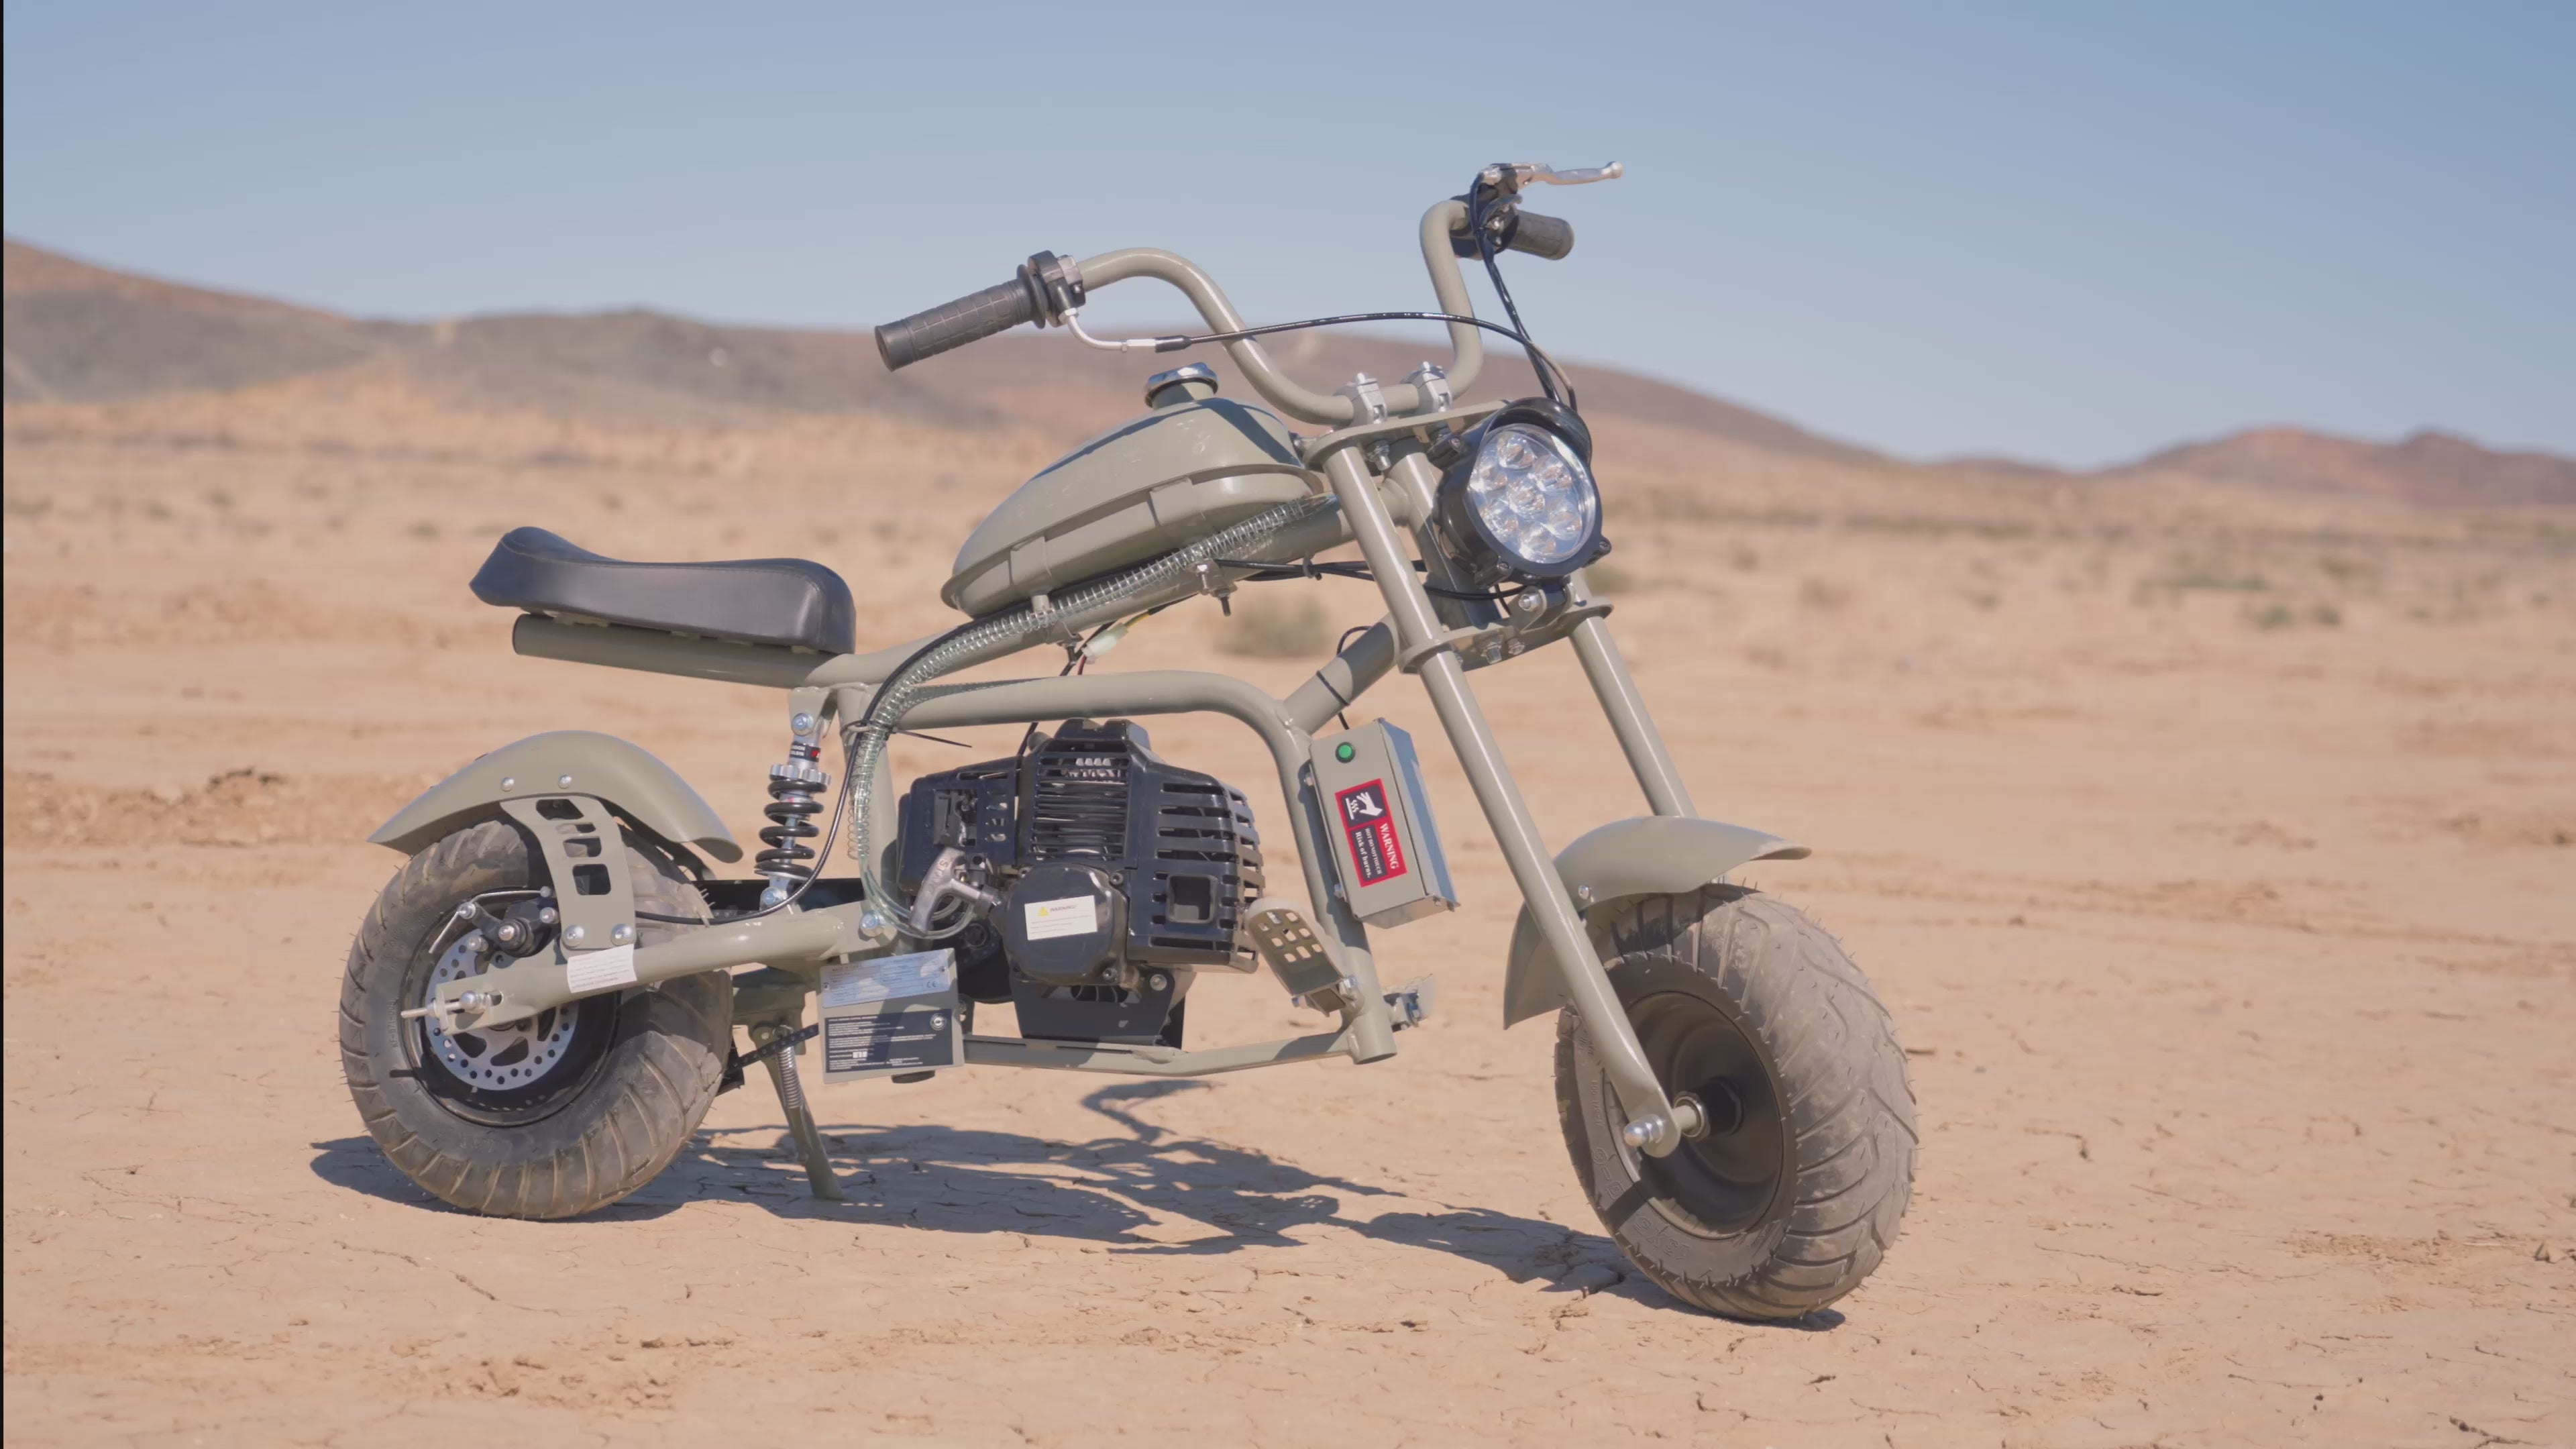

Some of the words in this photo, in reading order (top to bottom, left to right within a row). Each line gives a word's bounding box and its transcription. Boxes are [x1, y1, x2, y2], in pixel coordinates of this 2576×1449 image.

[1356, 832, 1364, 847] Risk
[1362, 855, 1372, 878] burns.
[1368, 839, 1375, 847] DO
[1373, 857, 1382, 874] TOUCH
[1380, 823, 1399, 869] WARNING
